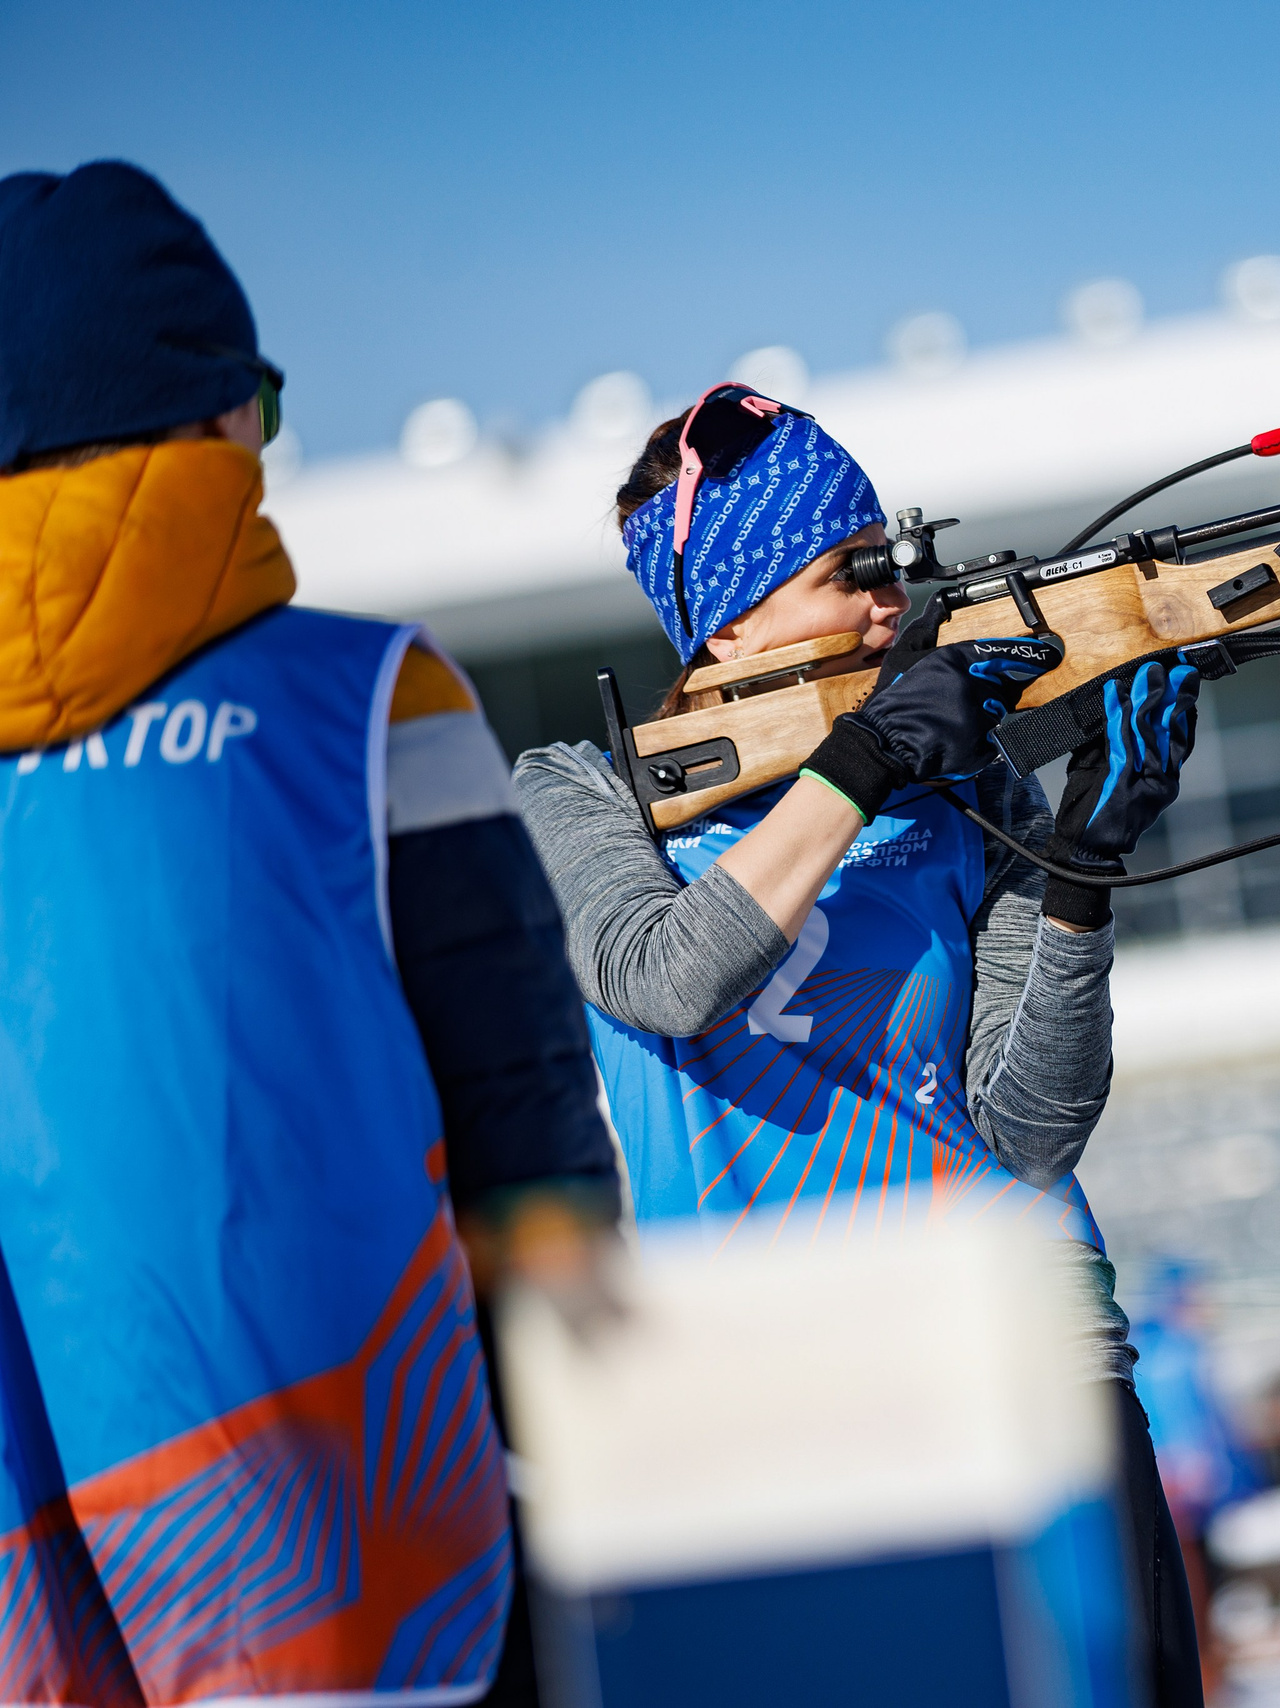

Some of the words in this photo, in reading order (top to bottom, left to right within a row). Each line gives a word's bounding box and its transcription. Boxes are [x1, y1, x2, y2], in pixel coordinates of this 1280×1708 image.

[731, 475, 781, 552] noname
[770, 461, 820, 538] noname
[747, 904, 830, 1043] 2
[915, 1062, 938, 1104] 2
